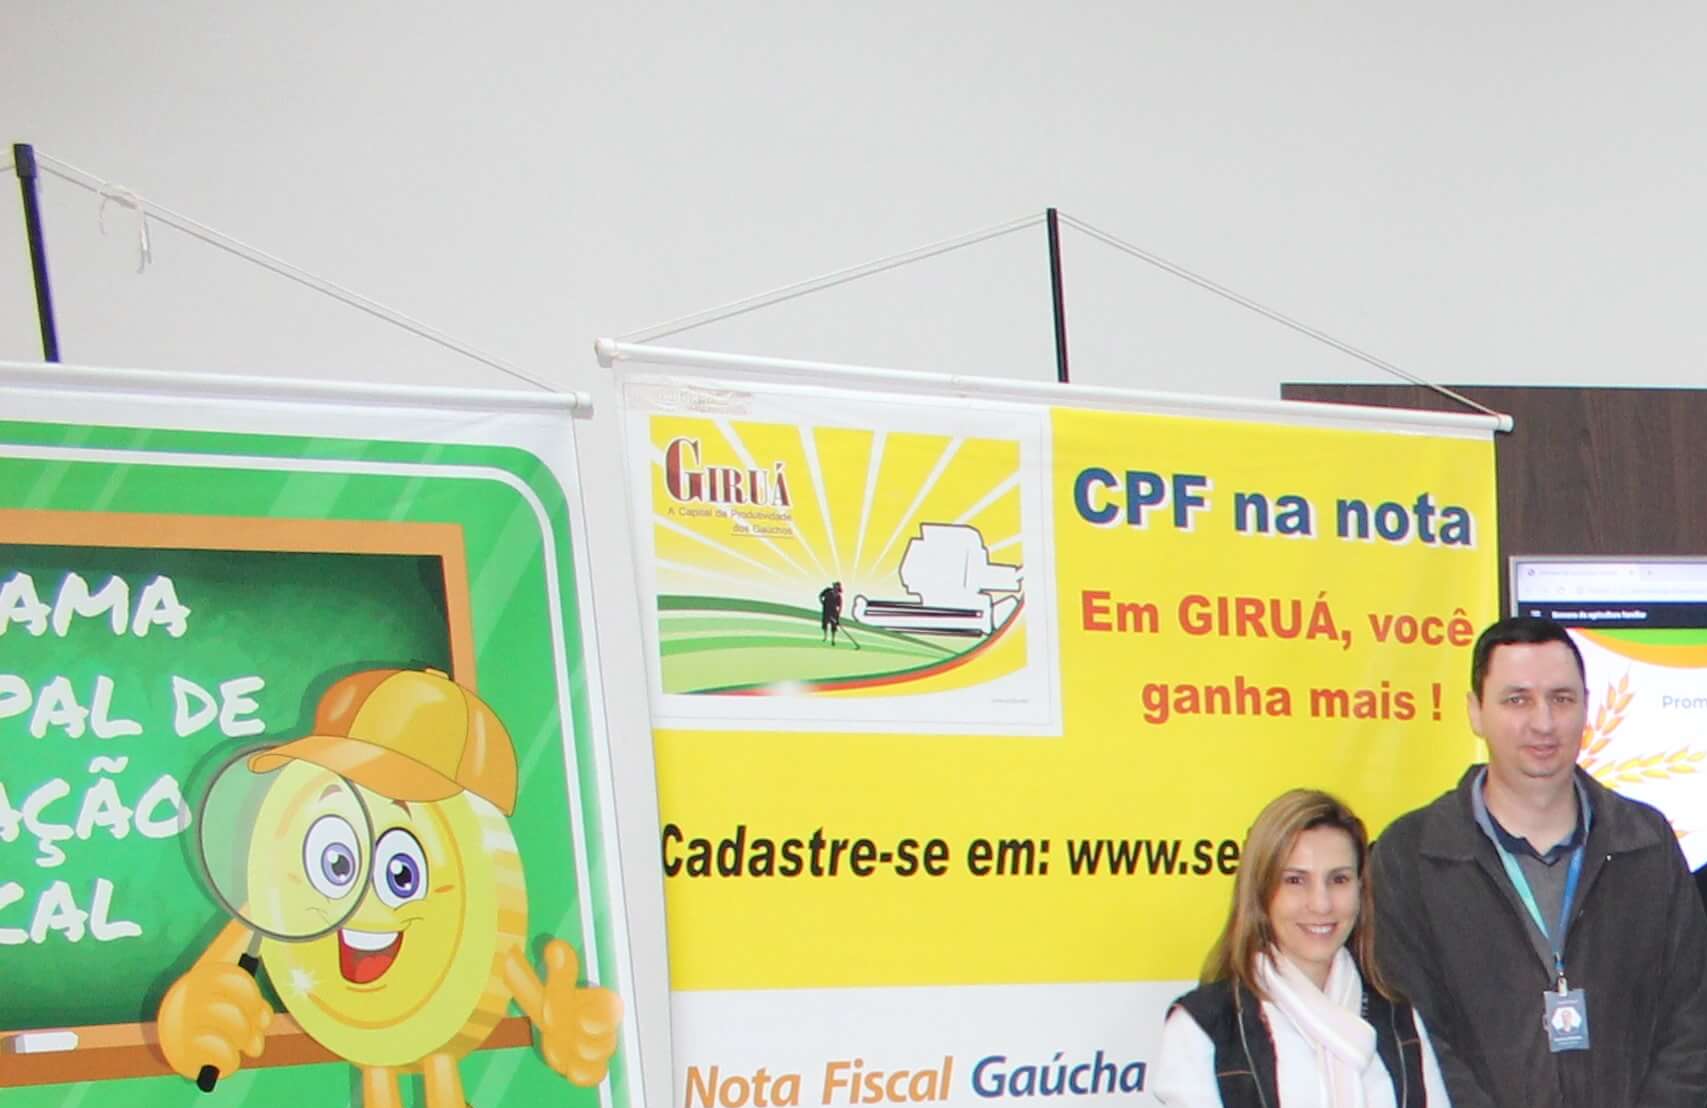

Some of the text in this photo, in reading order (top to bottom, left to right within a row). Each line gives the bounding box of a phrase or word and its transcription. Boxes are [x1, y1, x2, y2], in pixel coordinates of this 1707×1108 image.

[664, 438, 791, 507] GIRUÁ
[1073, 465, 1477, 548] CPF na nota
[0, 571, 191, 638] AMA
[1081, 589, 1474, 650] Em GIRUÁ, você
[171, 675, 266, 738] DE
[1141, 675, 1292, 726] ganha
[1309, 680, 1417, 721] mais
[661, 822, 950, 878] Cadastre-se
[966, 836, 1051, 878] em:
[820, 1055, 954, 1106] Fiscal
[970, 1050, 1147, 1100] Gaúcha
